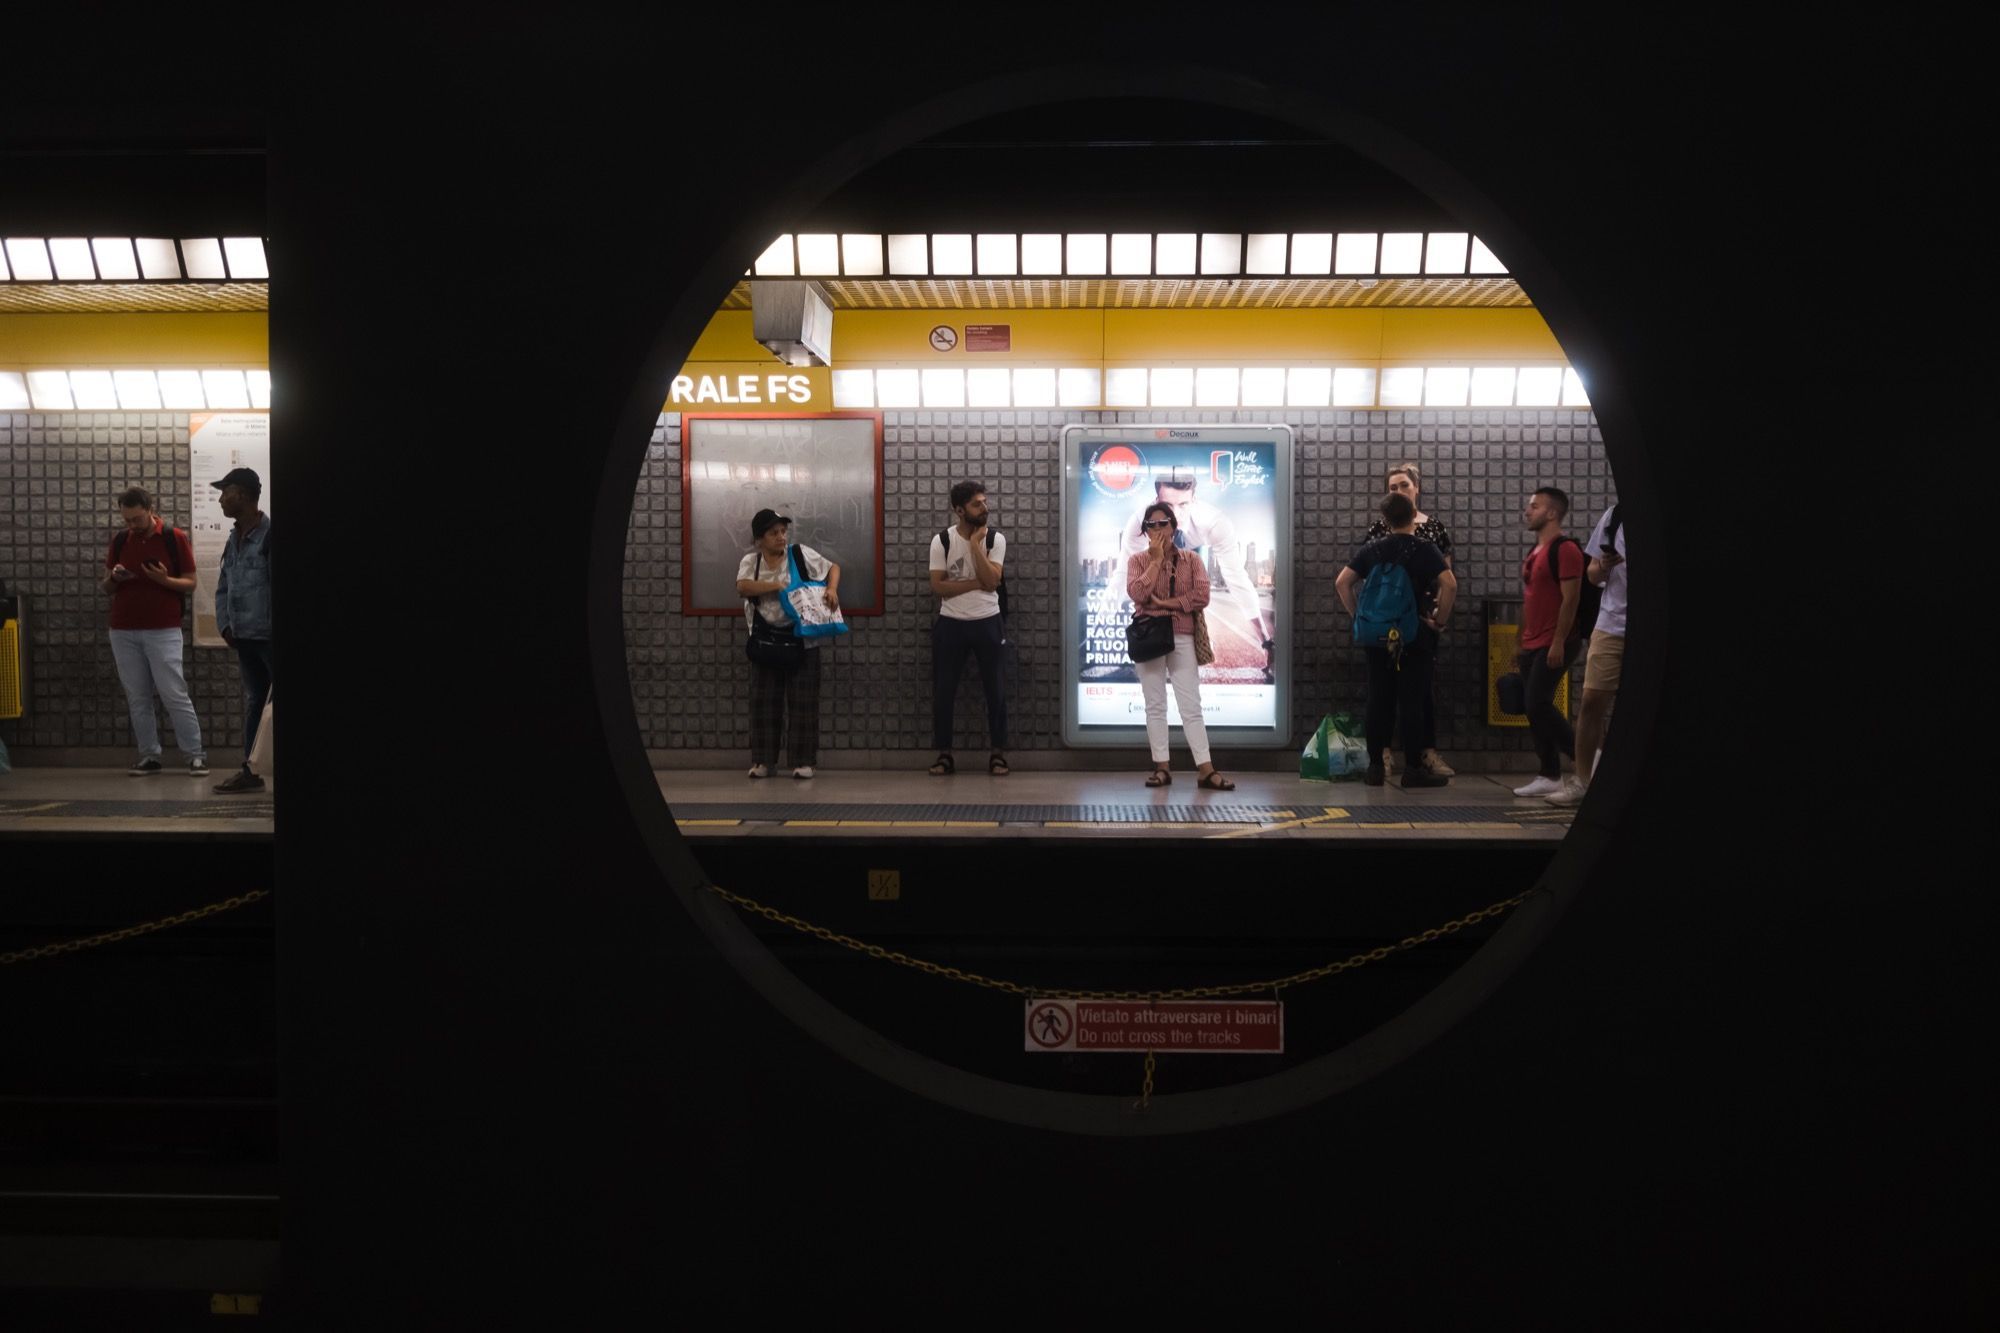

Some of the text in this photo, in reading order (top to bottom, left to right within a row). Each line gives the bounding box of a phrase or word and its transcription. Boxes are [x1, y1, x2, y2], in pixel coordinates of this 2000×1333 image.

[768, 375, 811, 403] FS
[1234, 450, 1257, 463] Wall
[1086, 589, 1118, 600] CON
[1086, 602, 1125, 613] WALL
[1086, 640, 1090, 651] I
[1086, 686, 1113, 695] IELTS
[1079, 1008, 1277, 1024] Vietato attraversare i binari
[1079, 1028, 1241, 1044] Do not cross the tracks
